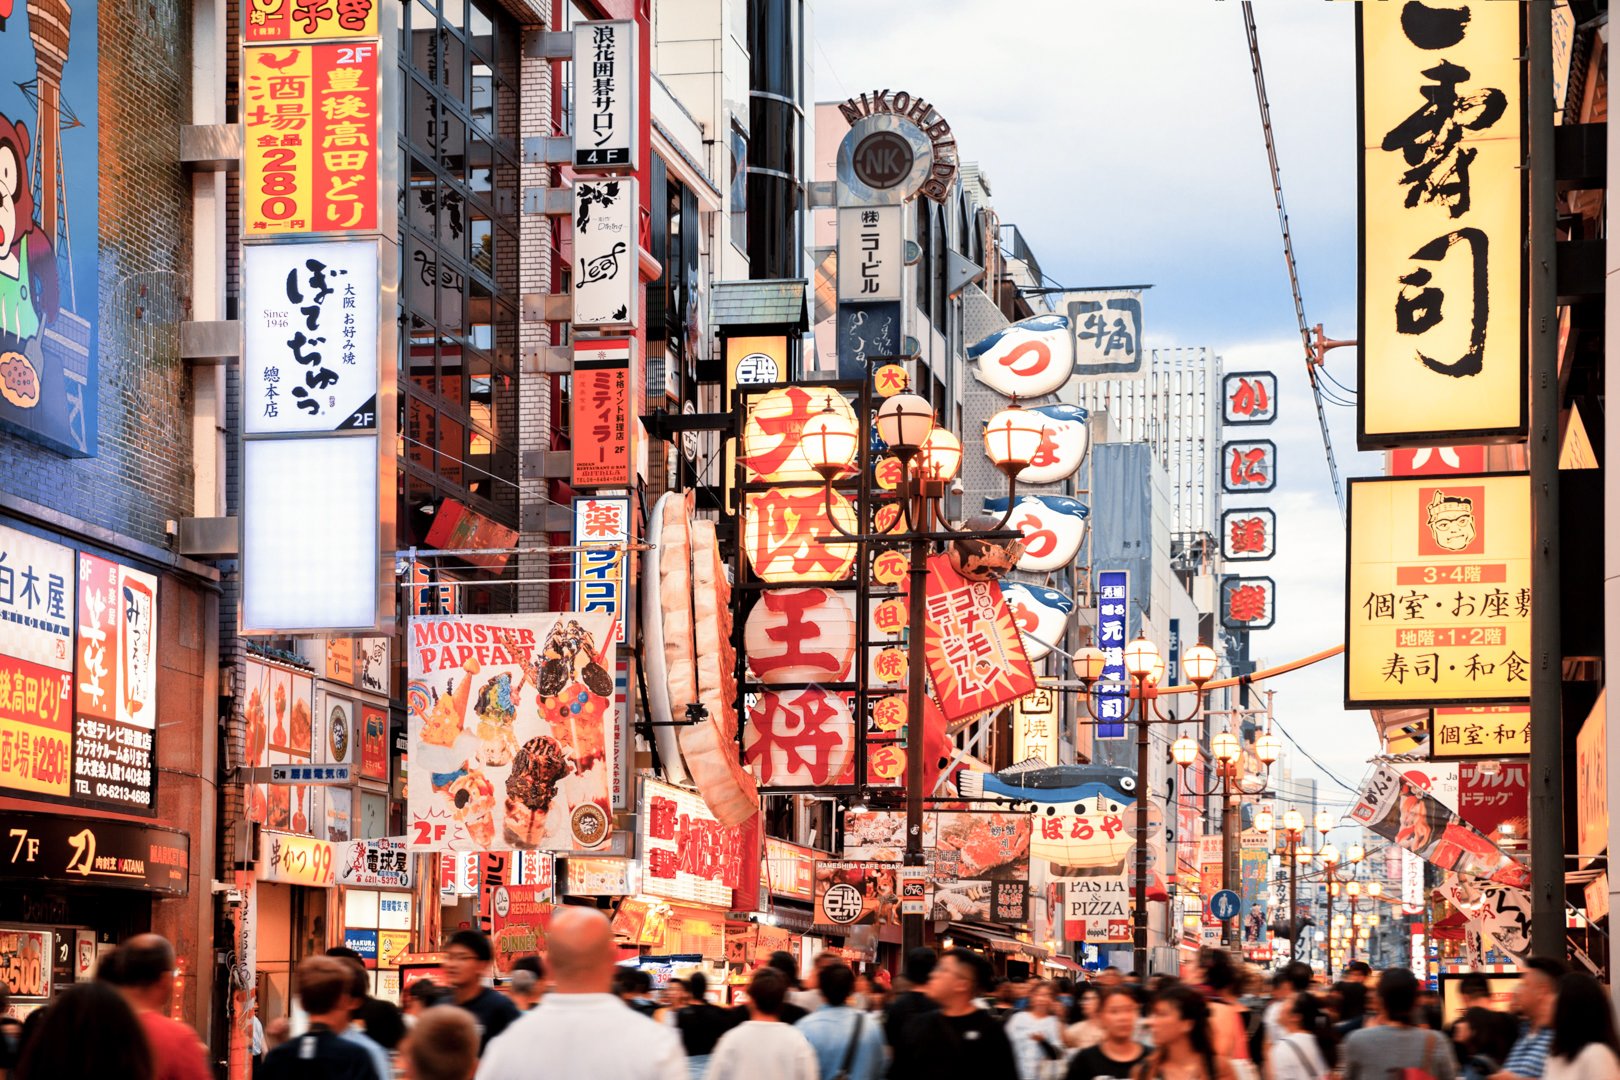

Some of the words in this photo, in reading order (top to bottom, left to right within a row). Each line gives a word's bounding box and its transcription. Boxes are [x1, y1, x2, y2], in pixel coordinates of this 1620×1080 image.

[336, 47, 372, 64] 2F
[592, 26, 616, 148] 浪花囲碁サロン
[247, 76, 311, 131] 酒場
[838, 88, 933, 127] NIKOH
[257, 134, 303, 147] 全品
[321, 67, 370, 227] 豊後高田どり
[866, 149, 899, 174] NK
[261, 148, 297, 220] 280
[575, 241, 627, 289] Leaf
[263, 309, 289, 319] Since
[266, 318, 289, 329] 1946
[342, 283, 357, 366] 大阪お好み焼
[286, 258, 348, 415] ぼてぢゅう
[1078, 313, 1134, 357] 牛角
[352, 412, 374, 426] 2F
[592, 371, 612, 463] ミティラー
[614, 445, 625, 454] 2F
[80, 559, 92, 581] 8F
[1424, 566, 1482, 583] 3・4階
[414, 621, 536, 647] MONSTER
[1400, 628, 1501, 646] 地階・1・2階
[61, 674, 70, 700] 2F
[77, 718, 152, 751] 大型テレビ設置店
[75, 780, 91, 795] TEL
[1462, 768, 1525, 788] ツルハ
[1461, 792, 1513, 807] ドラッグ
[413, 822, 446, 845] 2F
[9, 828, 40, 863] 7F
[118, 858, 145, 874] KATANA
[313, 843, 332, 884] 99
[366, 849, 407, 873] 電球屋
[510, 891, 533, 901] INDIAN
[510, 903, 550, 914] RESTAURANT
[1072, 901, 1125, 915] PIZZA
[1110, 925, 1126, 936] 2F
[501, 935, 536, 952] DINNER
